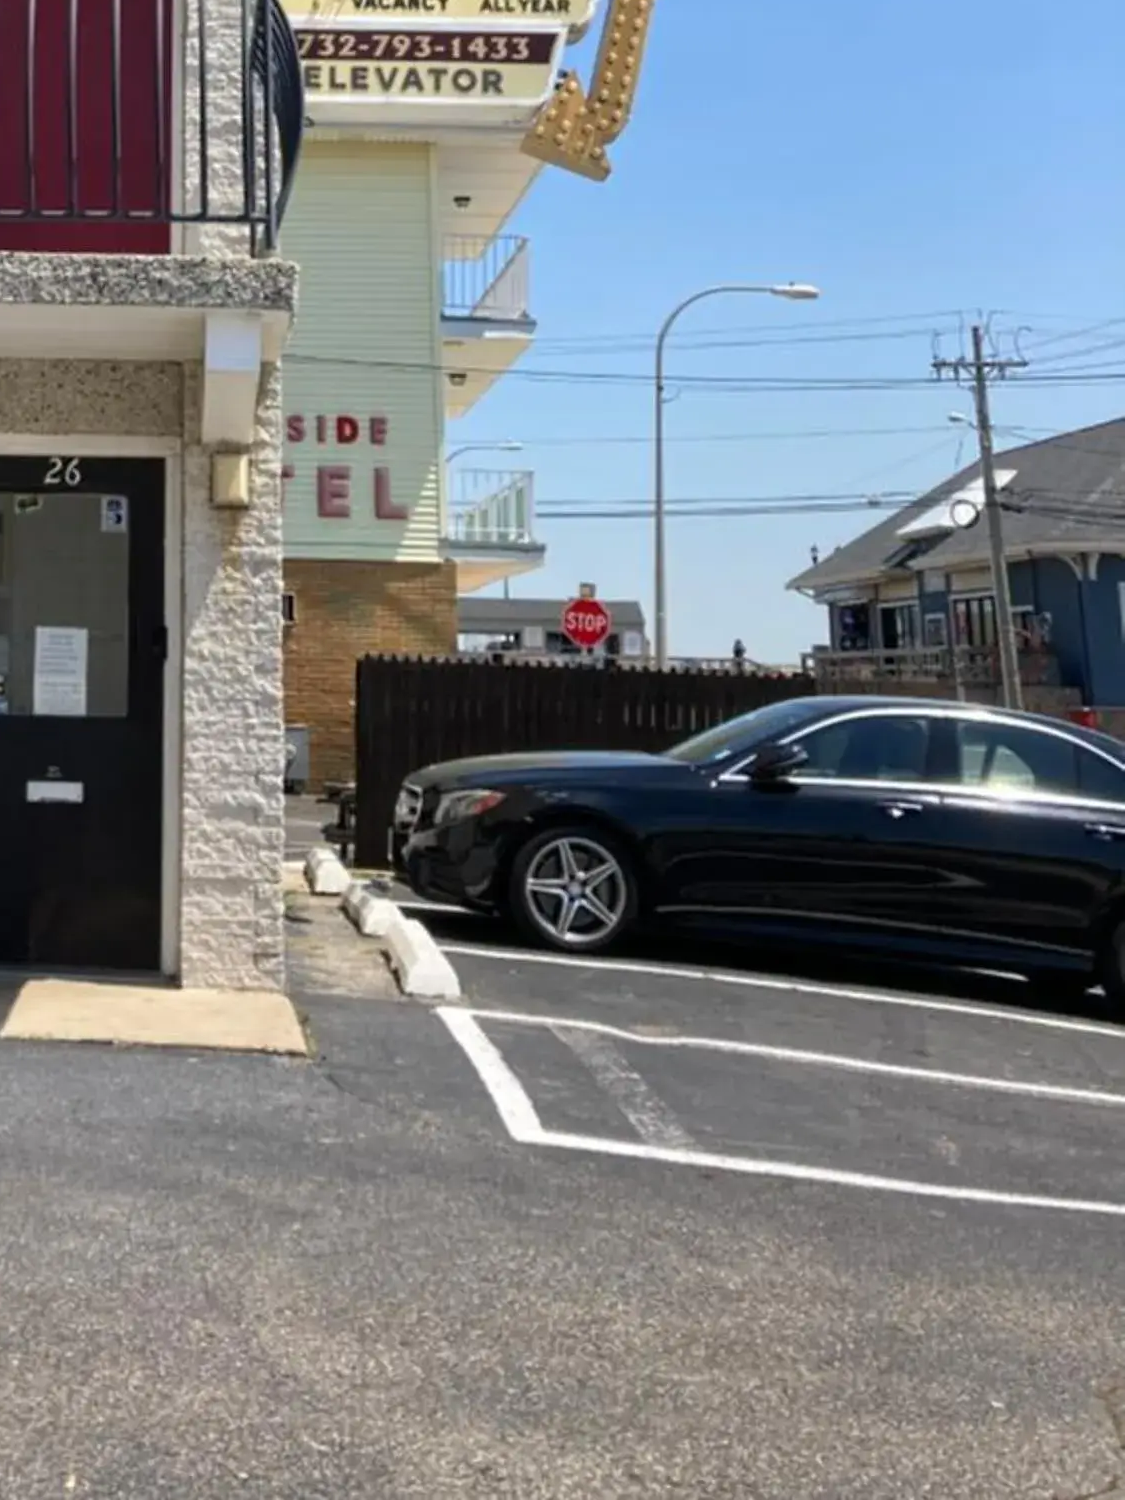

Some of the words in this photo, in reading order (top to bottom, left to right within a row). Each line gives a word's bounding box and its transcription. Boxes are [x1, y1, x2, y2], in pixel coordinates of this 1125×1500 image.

[298, 33, 531, 61] 732-793-1433
[304, 65, 504, 95] ELEVATOR
[286, 414, 388, 446] SIDE
[43, 457, 82, 486] 26
[565, 611, 606, 634] STOP
